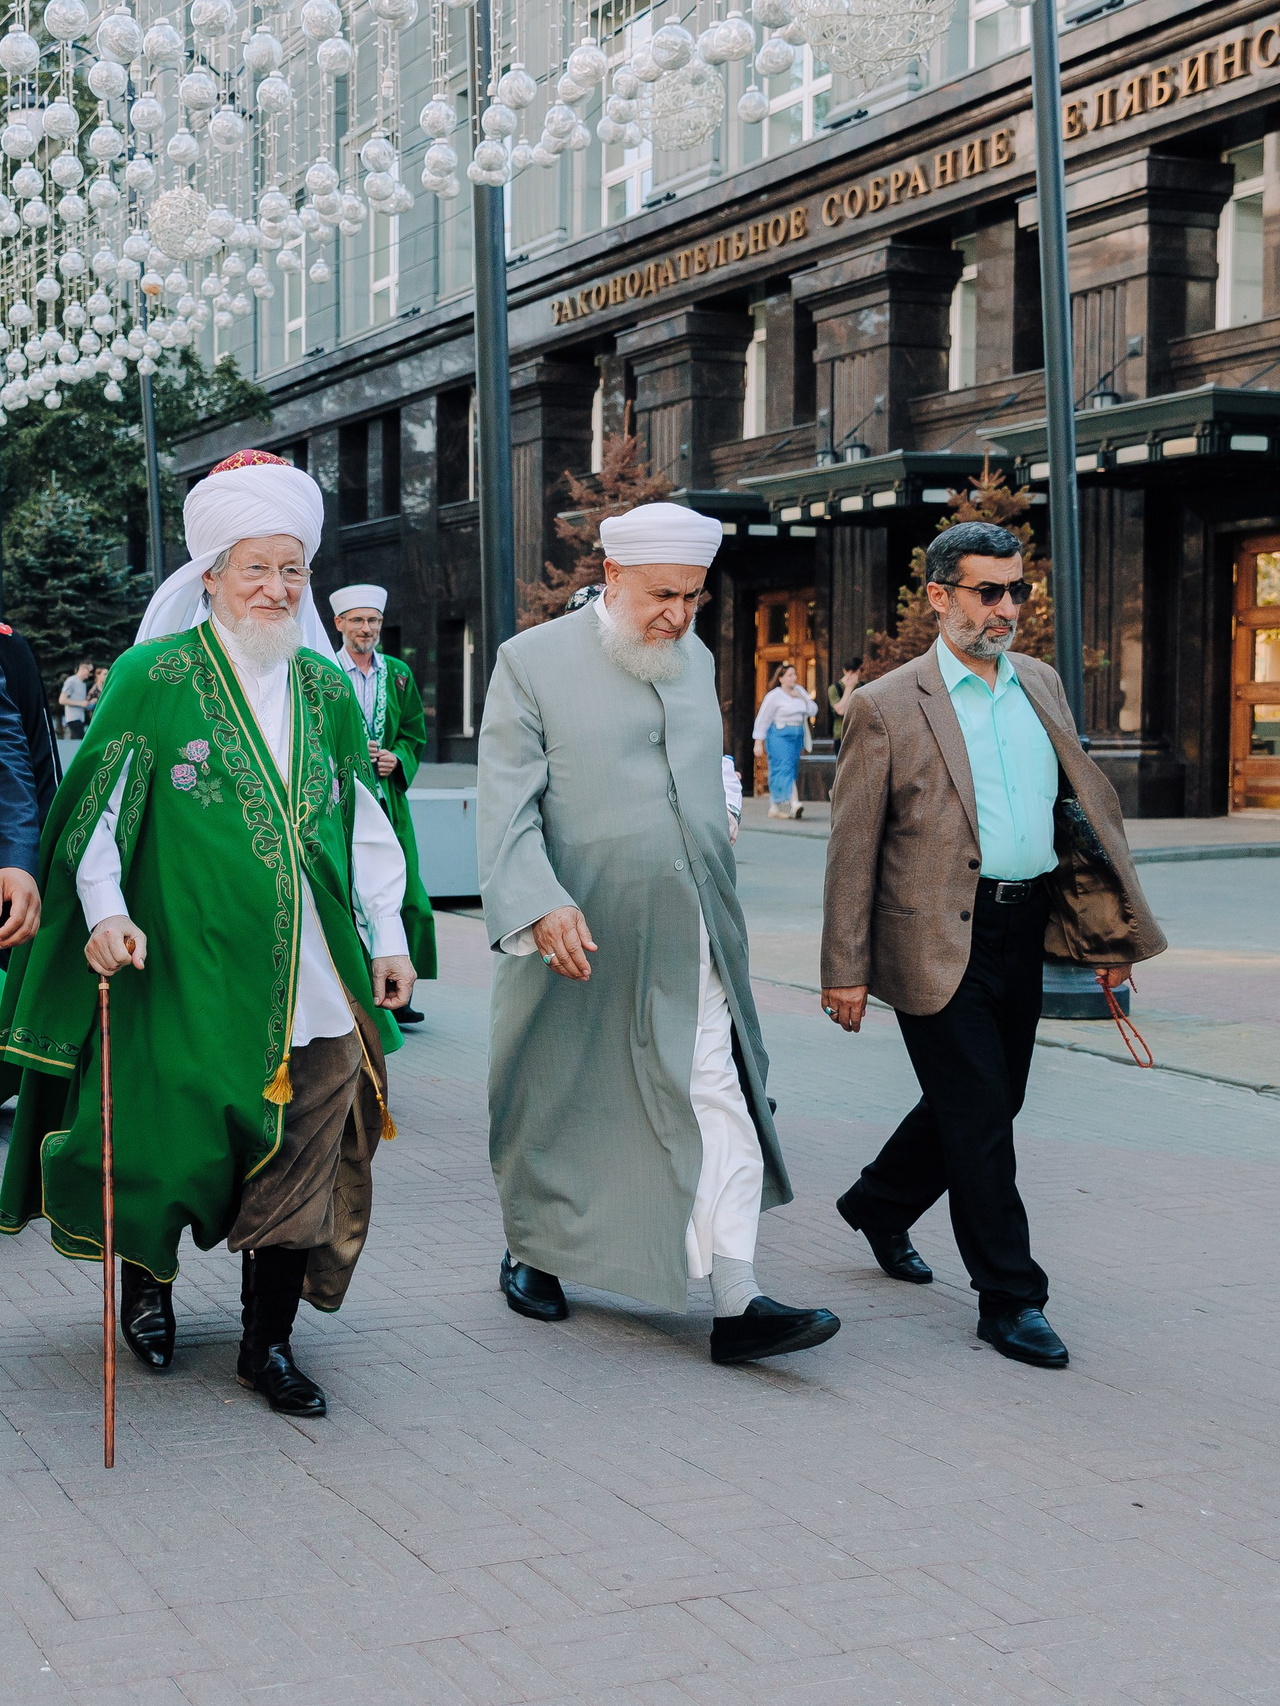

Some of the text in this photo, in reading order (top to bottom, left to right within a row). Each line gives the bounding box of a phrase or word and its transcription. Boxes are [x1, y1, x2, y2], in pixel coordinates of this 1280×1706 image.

[551, 25, 1280, 326] ЗАКОНОДАТЕЛЬНОЕ СОБРАНИЕ ЕЛЯБИНС
